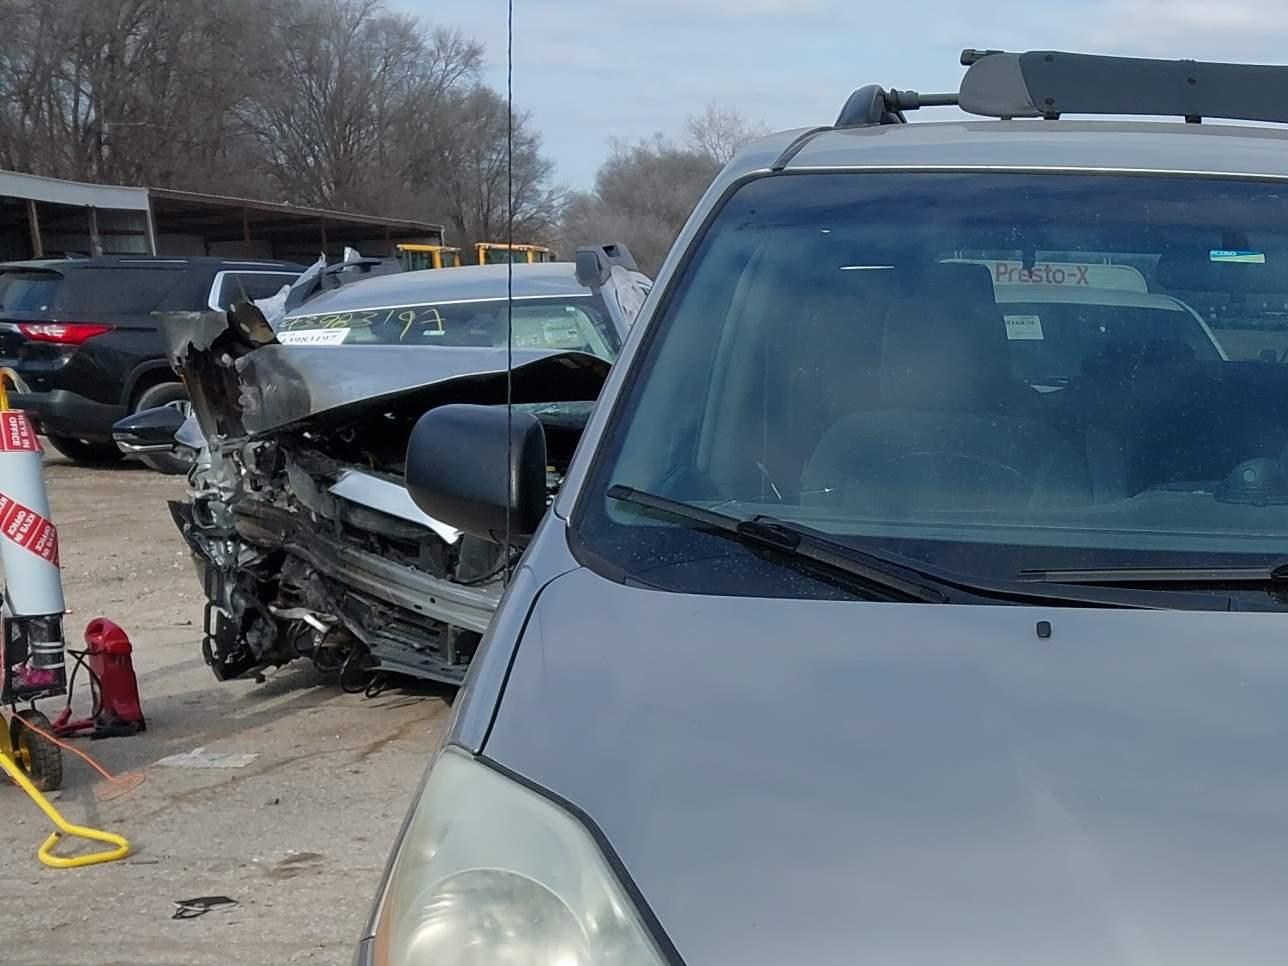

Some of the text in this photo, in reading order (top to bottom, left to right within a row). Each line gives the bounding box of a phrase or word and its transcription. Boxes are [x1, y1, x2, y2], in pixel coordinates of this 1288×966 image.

[995, 263, 1089, 285] Presto-X
[9, 416, 21, 447] OFFICE
[7, 510, 26, 536] OFFICE
[14, 513, 36, 542] KEYS IN
[34, 525, 51, 551] OFFICE
